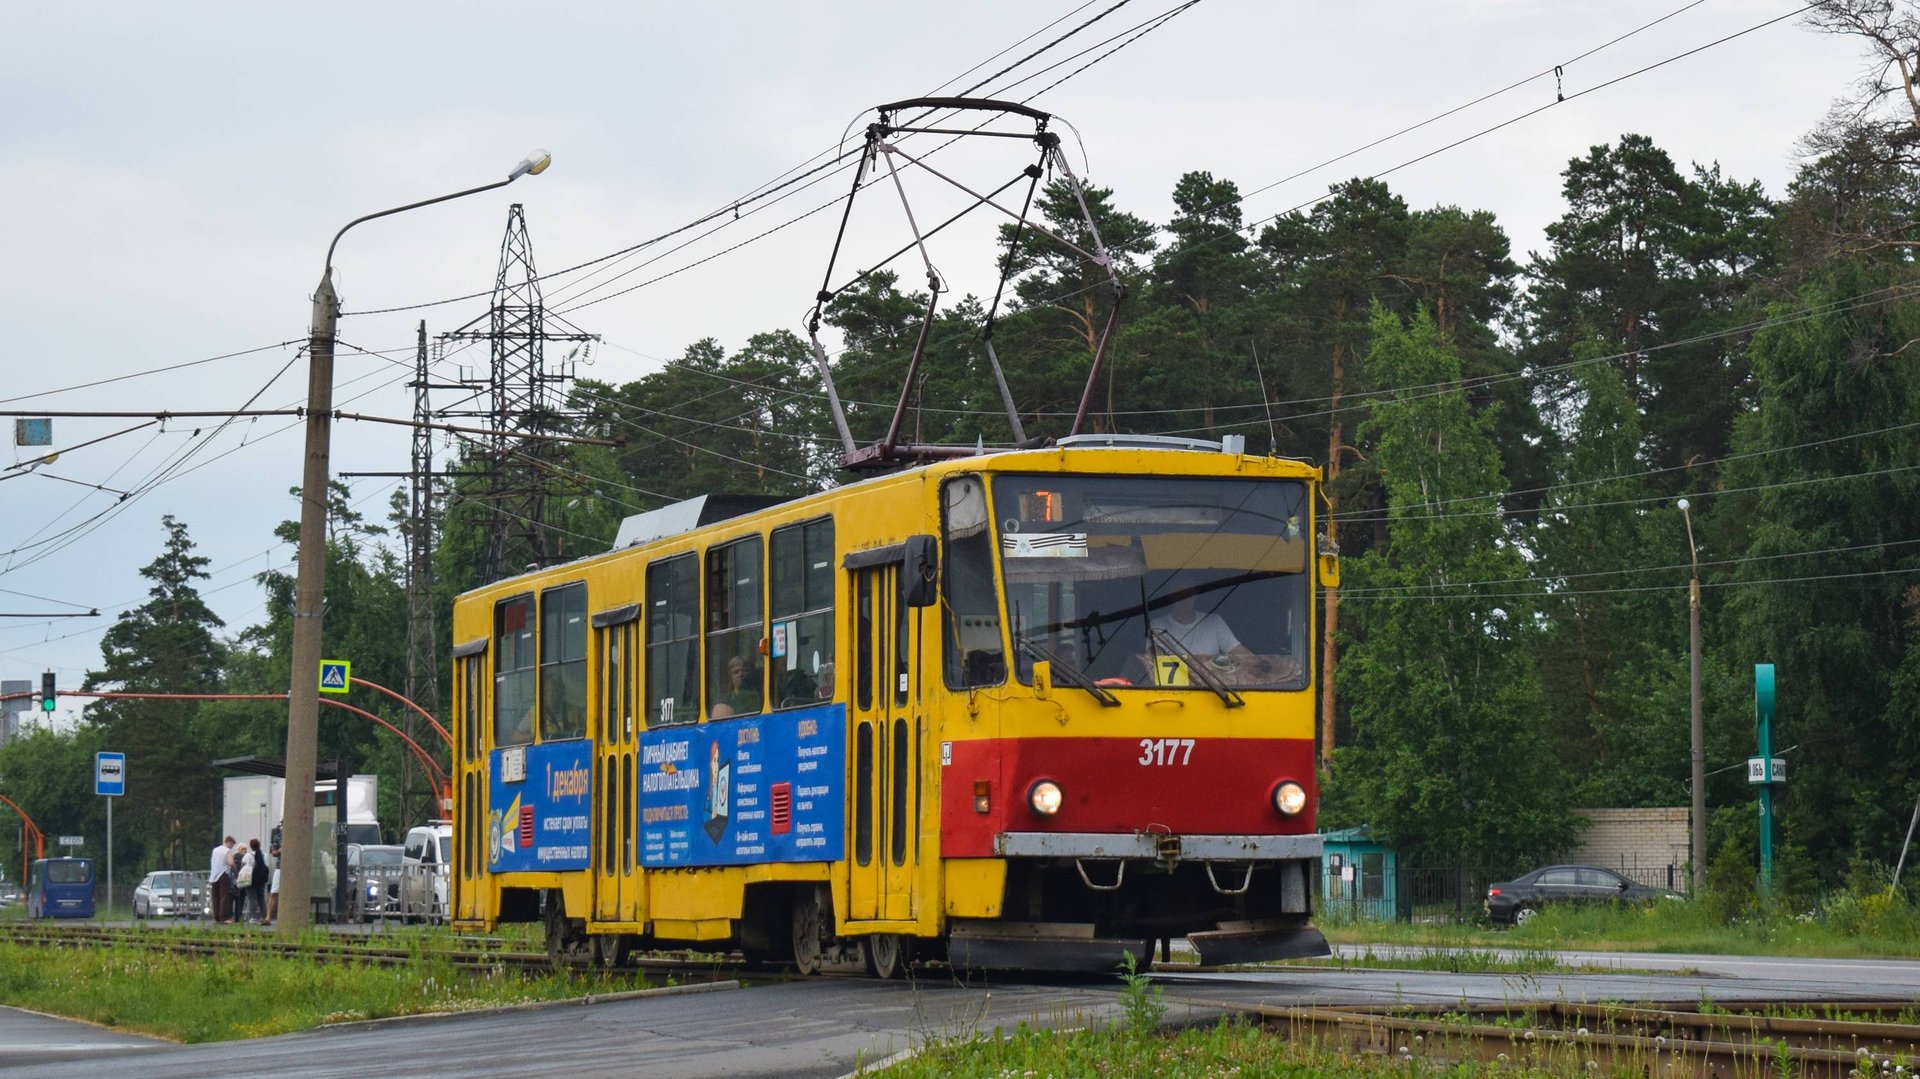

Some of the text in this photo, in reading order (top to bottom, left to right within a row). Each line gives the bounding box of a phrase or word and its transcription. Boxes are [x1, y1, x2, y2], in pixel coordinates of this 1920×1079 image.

[1036, 491, 1052, 522] 7
[1162, 662, 1180, 684] 7
[643, 739, 689, 765] ЛИЧНЫЙ КАБИНЕТ
[1138, 739, 1196, 766] 3177
[547, 762, 551, 796] 1
[552, 759, 589, 805] декабря
[643, 768, 699, 793] НАЛОГОПЛАТЕЛЬЩИКА
[544, 817, 562, 831] истекает
[562, 817, 572, 834] срок
[537, 845, 587, 864] имущественных налогов
